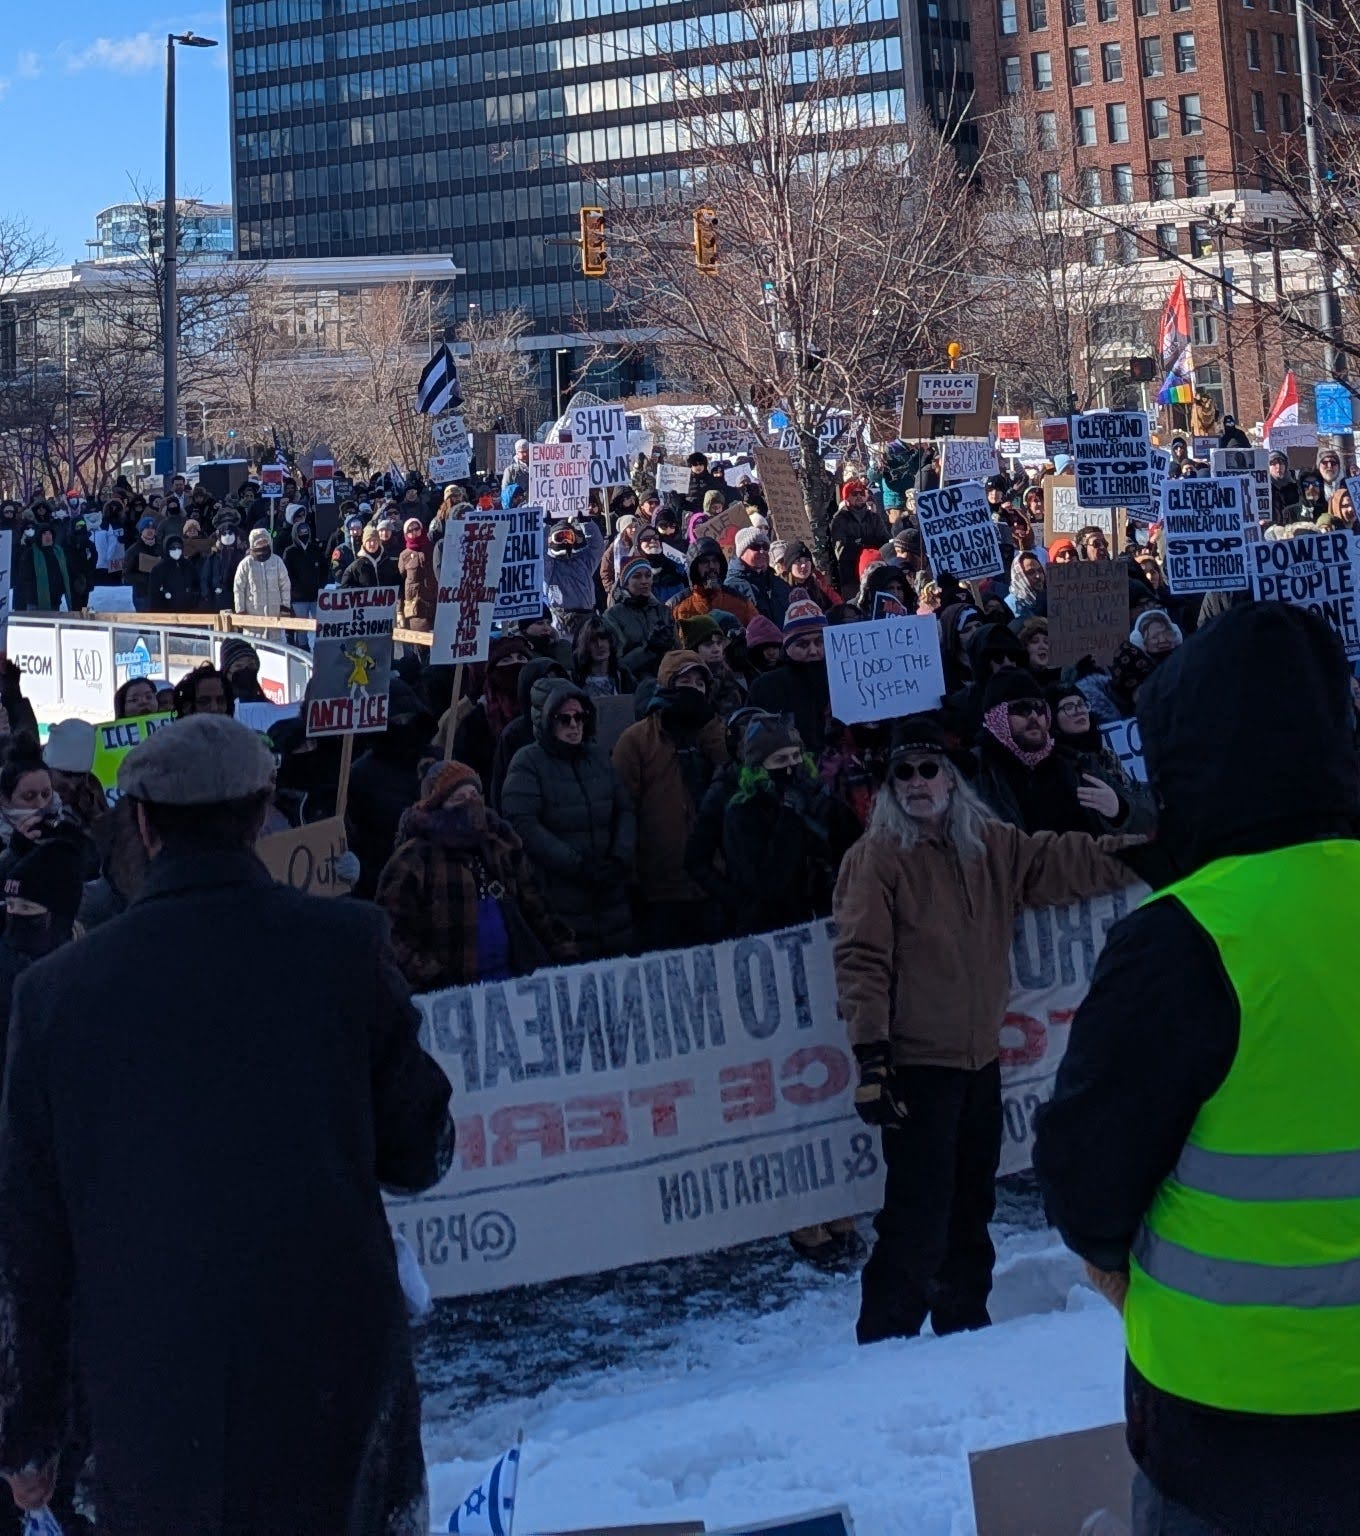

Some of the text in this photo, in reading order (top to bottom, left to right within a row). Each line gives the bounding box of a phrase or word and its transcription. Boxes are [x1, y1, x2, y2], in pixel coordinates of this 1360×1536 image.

[924, 379, 974, 389] TRUCK
[437, 420, 459, 436] ICE
[576, 409, 624, 436] SHUT
[1078, 419, 1143, 439] CLEVELAND
[533, 445, 565, 461] ENOUGH
[587, 436, 615, 459] IT
[1076, 442, 1147, 459] MINNEAPOLIS
[590, 454, 631, 484] OWN
[1077, 461, 1149, 476] STOP
[561, 477, 583, 495] OUT
[1078, 476, 1149, 496] ICE TERROR
[917, 488, 963, 519] STOP
[962, 498, 985, 510] THE
[1168, 487, 1236, 511] CLEVELAND
[518, 514, 540, 532] THE
[923, 508, 990, 536] REPRESSION
[1167, 514, 1240, 534] MINNEAPOLIS
[930, 526, 995, 557] ABOLISH
[1168, 538, 1243, 555] STOP
[933, 545, 998, 574] ICE NOW!
[1255, 534, 1350, 574] POWER
[1169, 555, 1245, 579] ICE TERROR
[1259, 564, 1354, 601] PEOPLE
[318, 589, 396, 611] CLEVELAND
[831, 627, 920, 659] MELT ICE!
[15, 653, 53, 676] AECOM
[73, 648, 103, 681] K&D
[840, 653, 933, 684] FLOOD THE
[857, 678, 920, 709] SYSTEM
[101, 723, 140, 750] ICE
